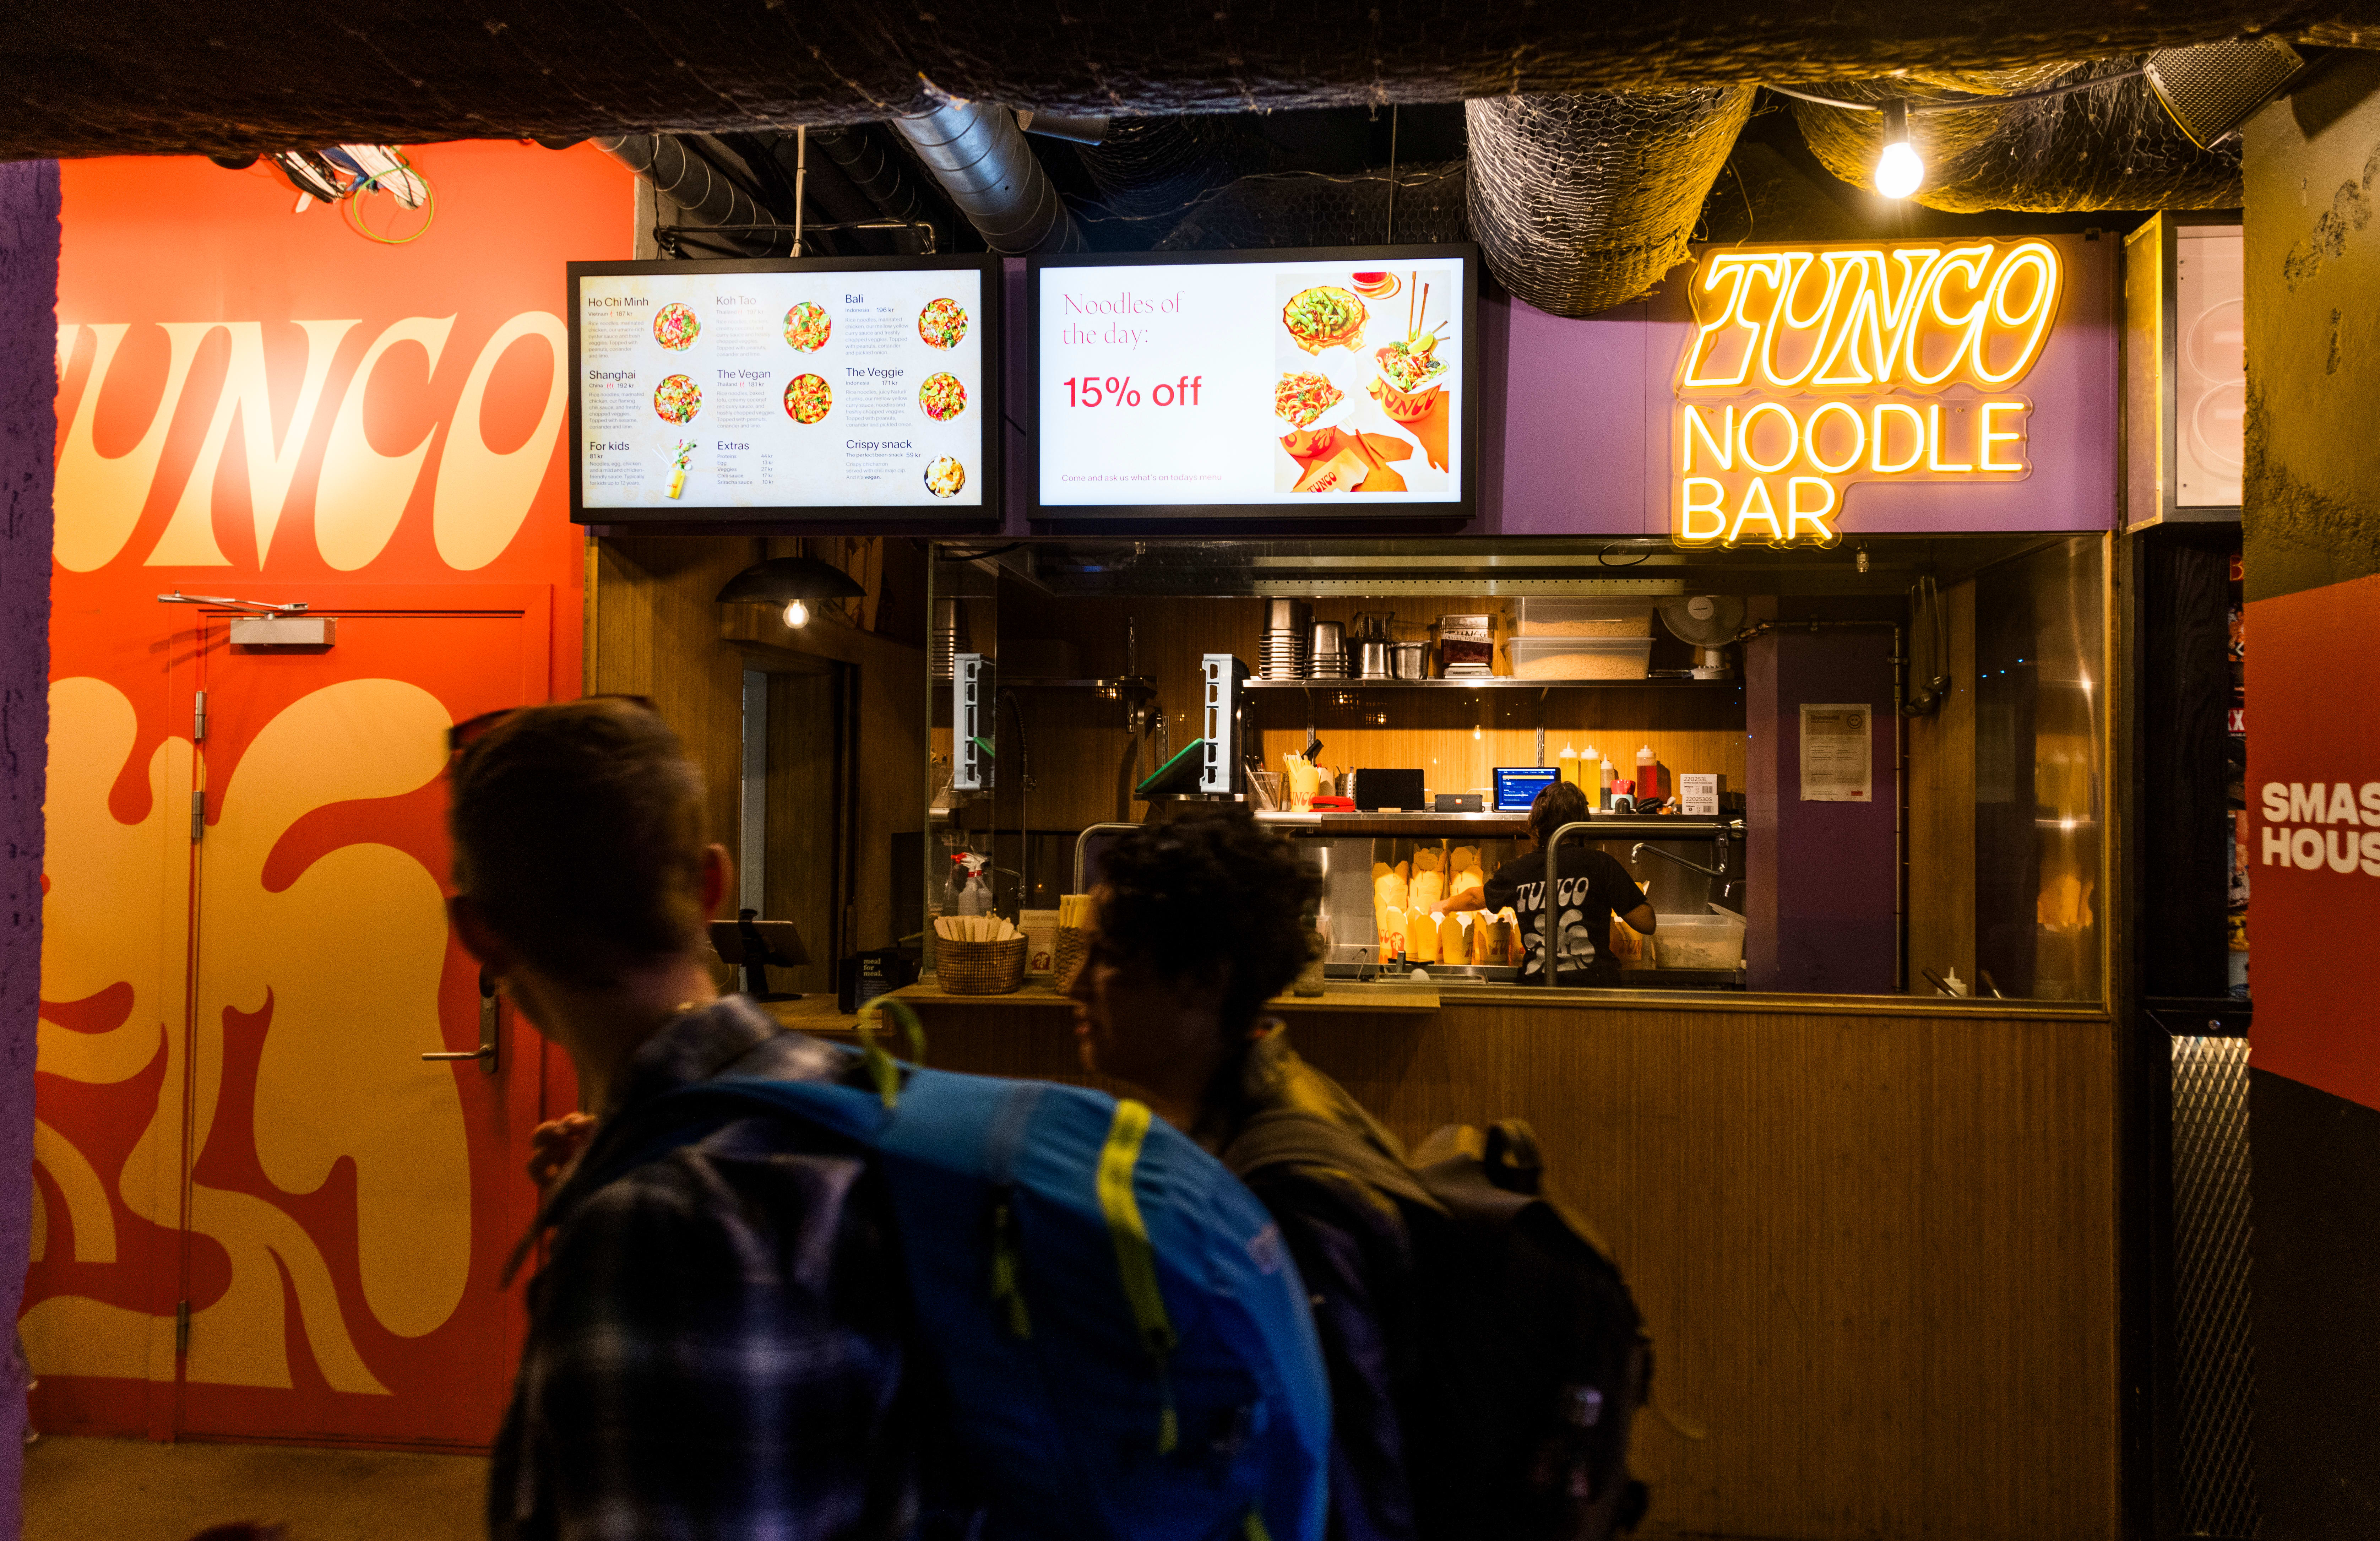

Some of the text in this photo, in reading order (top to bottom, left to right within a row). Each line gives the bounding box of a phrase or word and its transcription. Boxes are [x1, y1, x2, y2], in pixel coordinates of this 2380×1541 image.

[589, 298, 648, 306] Ho Chi Minh
[717, 296, 756, 305] Koh Tao
[846, 294, 863, 303] Bali
[1063, 291, 1185, 314] Noodles of
[1684, 243, 2056, 386] TUNCO
[1062, 322, 1147, 350] the day:
[589, 370, 636, 381] Shanghai
[717, 370, 771, 380] The Vegan
[846, 368, 903, 378] The Veggie
[1064, 375, 1202, 407] 15% off
[1378, 380, 1442, 416] TUNCO
[1683, 402, 2025, 473] NOODLE
[590, 441, 629, 450] For kids
[718, 441, 749, 450] Extras
[847, 440, 912, 450] Crispy snack
[1171, 474, 1197, 482] todays
[1307, 472, 1337, 493] TUNCO
[1681, 476, 1832, 541] BAR
[1516, 877, 1590, 913] TUCO
